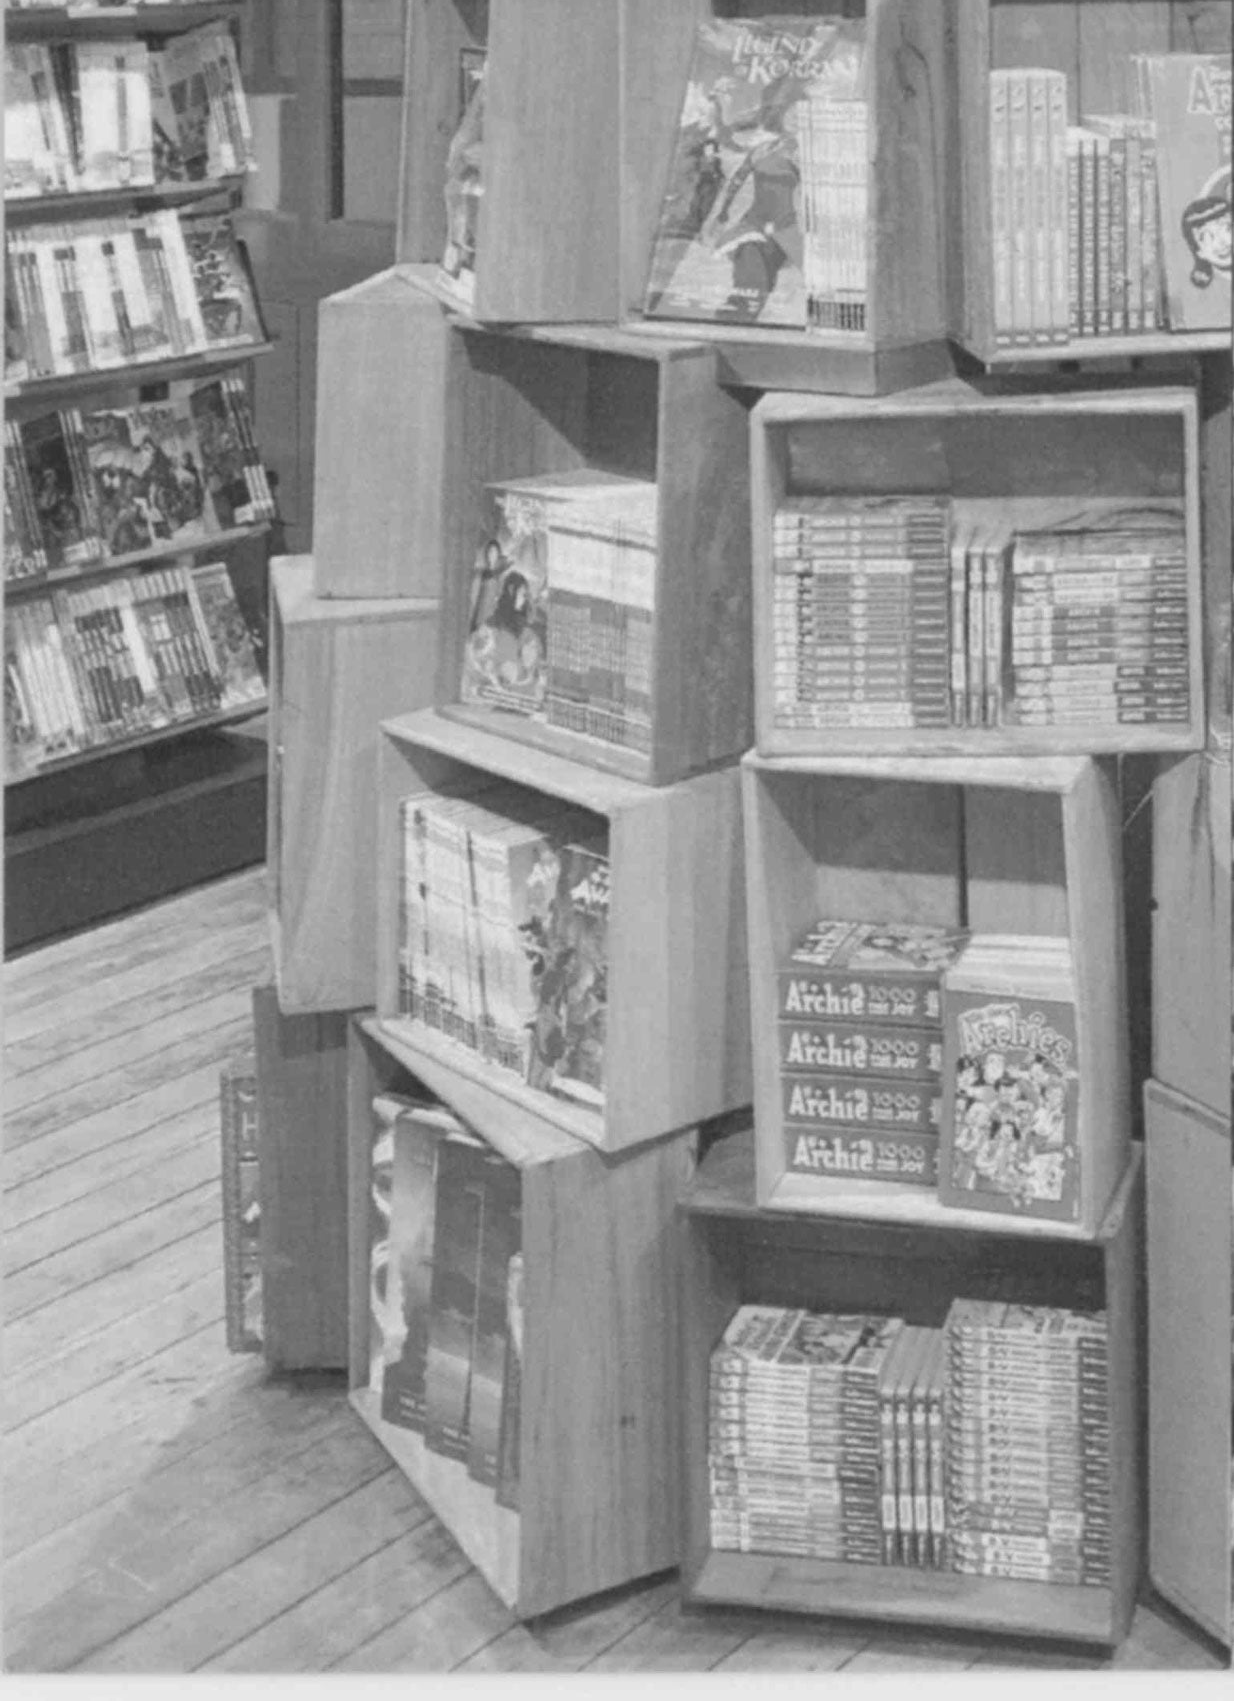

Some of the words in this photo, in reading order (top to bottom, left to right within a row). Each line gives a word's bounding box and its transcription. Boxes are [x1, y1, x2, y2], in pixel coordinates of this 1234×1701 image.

[785, 979, 865, 1015] Archie
[869, 986, 917, 1003] 1000
[787, 1031, 867, 1069] Archie
[870, 1038, 919, 1056] 1000
[788, 1084, 870, 1121] Archie
[872, 1092, 921, 1109] 1000
[793, 1135, 875, 1172] Archie
[876, 1142, 925, 1160] 1000
